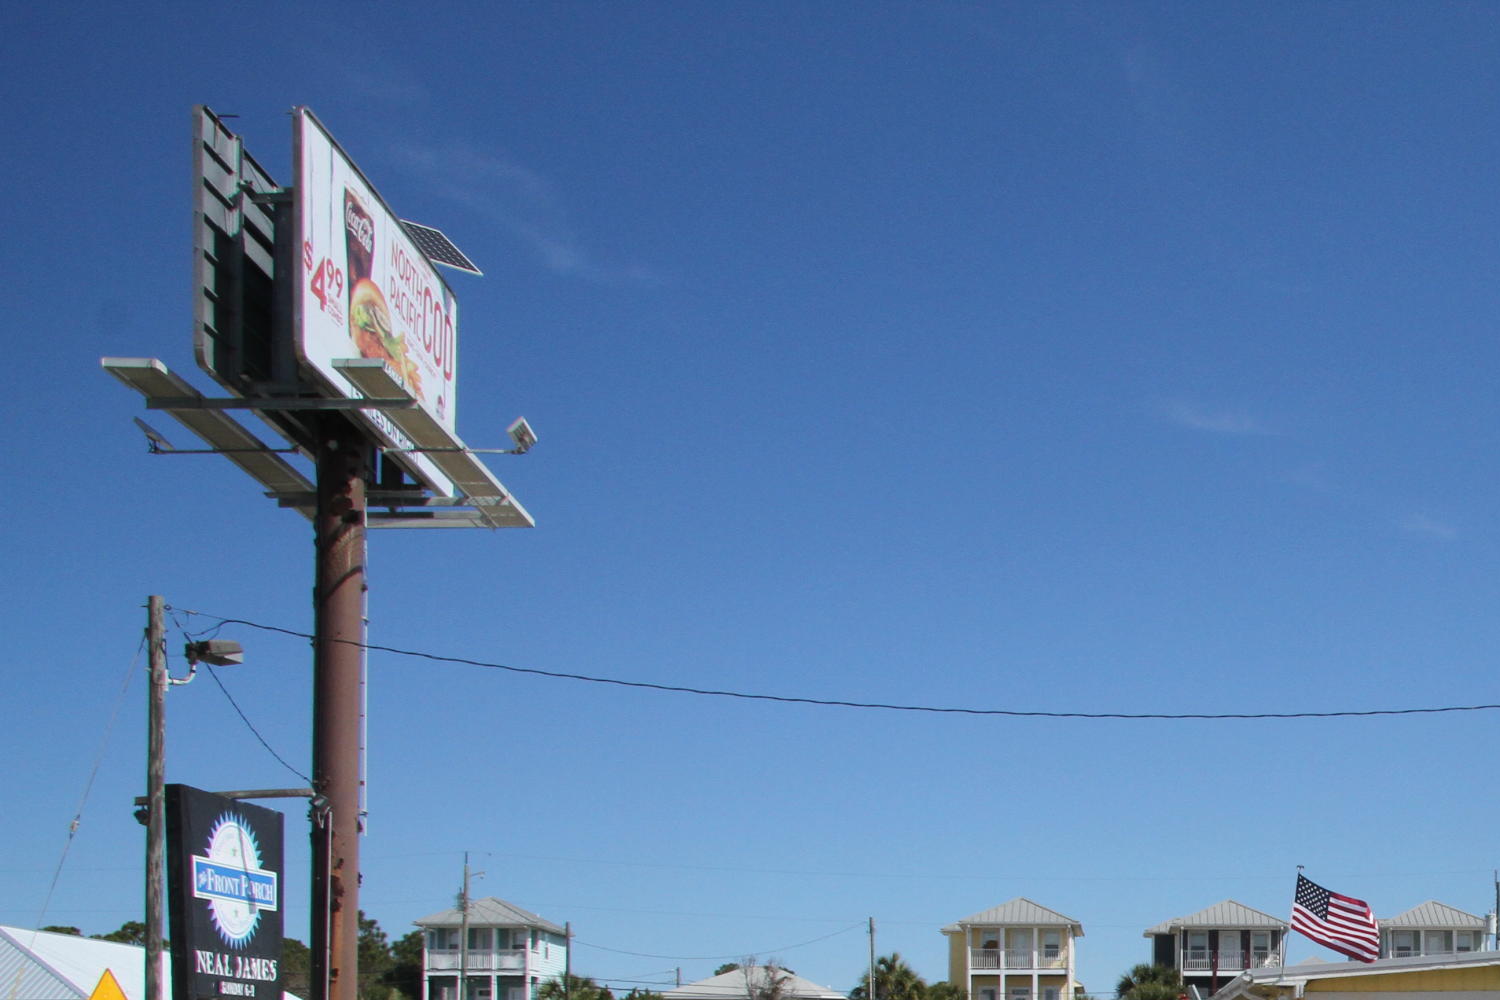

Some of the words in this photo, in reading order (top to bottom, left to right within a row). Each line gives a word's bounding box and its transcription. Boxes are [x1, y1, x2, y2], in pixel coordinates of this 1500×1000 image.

[391, 240, 423, 307] NORTH
[390, 275, 422, 342] PACIFIC
[423, 286, 453, 381] COD
[206, 868, 240, 896] FRONT
[195, 949, 233, 977] NEAL
[235, 955, 277, 981] JAMES
